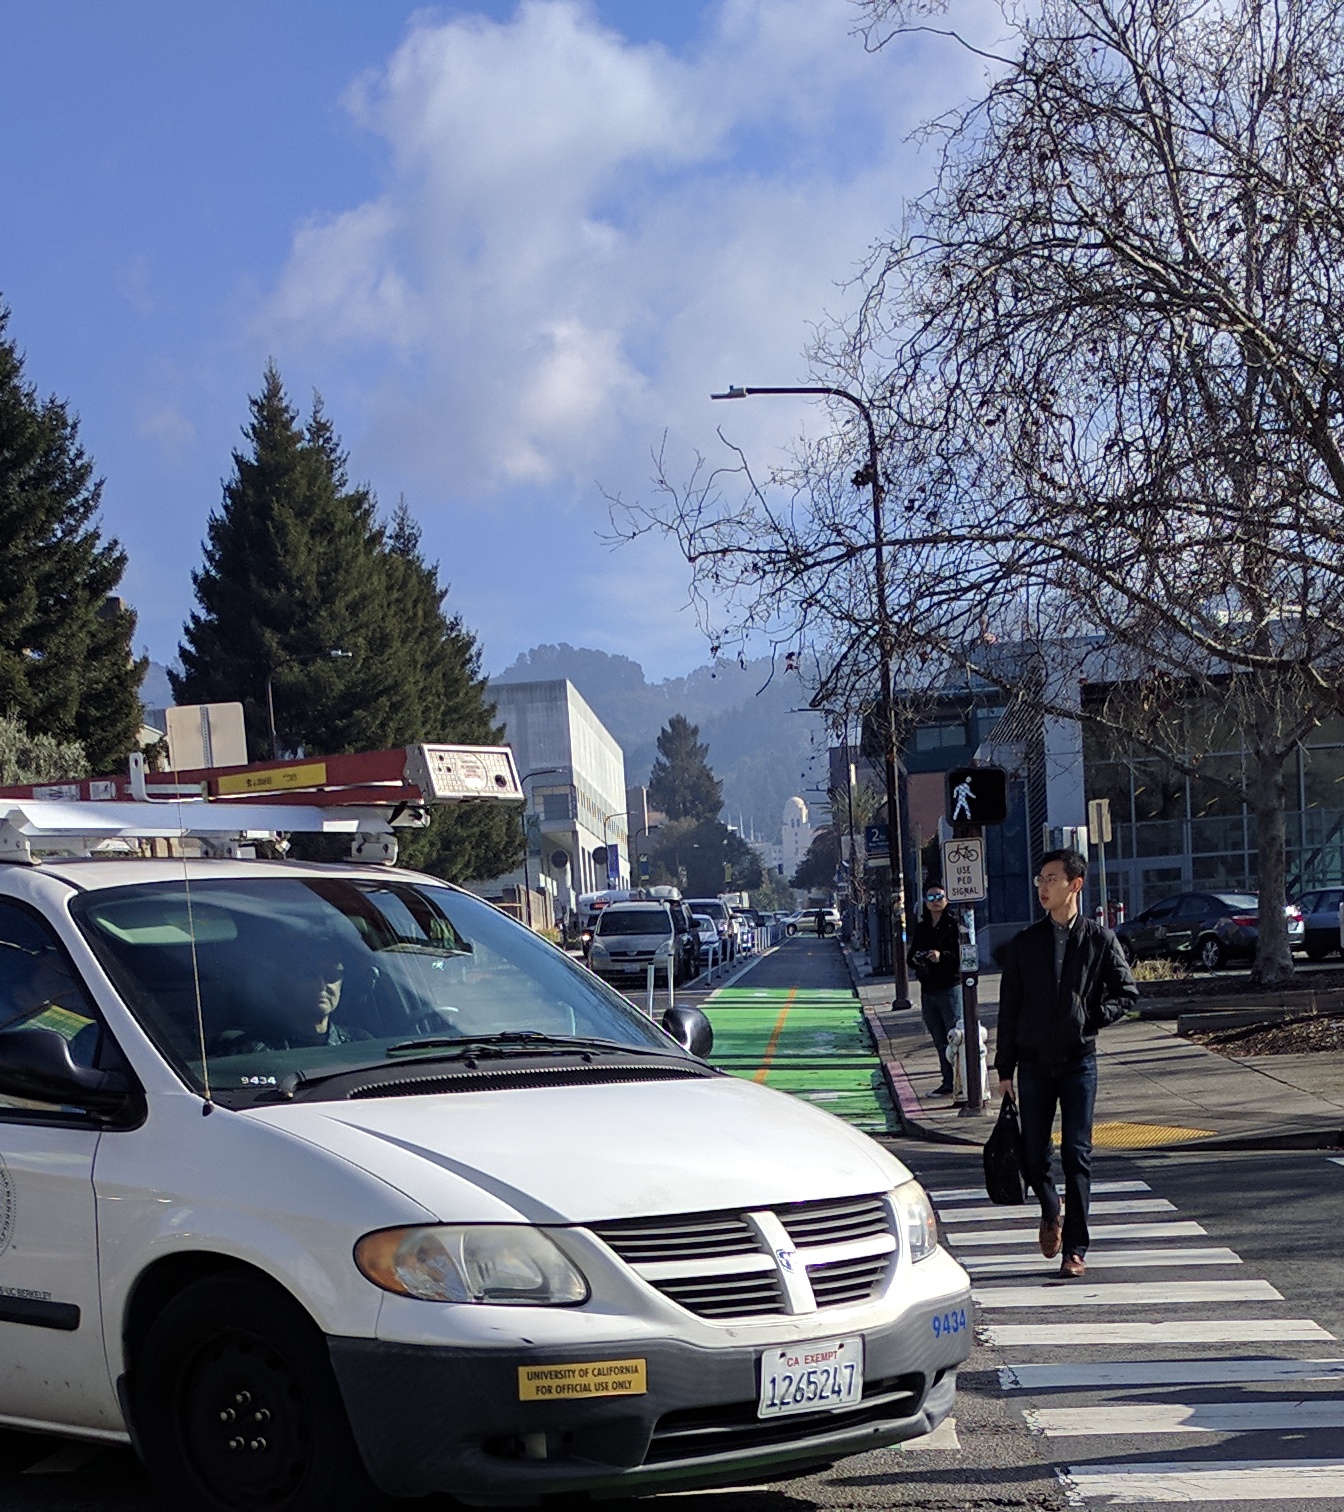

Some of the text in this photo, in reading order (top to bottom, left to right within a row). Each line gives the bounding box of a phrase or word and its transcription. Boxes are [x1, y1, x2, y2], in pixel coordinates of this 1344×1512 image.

[956, 865, 971, 875] USE
[957, 876, 972, 885] PED
[952, 886, 979, 896] SIGNAL
[240, 1075, 277, 1085] 9434
[932, 1308, 966, 1339] 9434
[786, 1350, 838, 1368] CA EXEMPT
[527, 1365, 639, 1381] UNIVERSITY OF CALIFORNIA
[536, 1380, 632, 1395] FOR OFFICIAL USE ONLY
[765, 1363, 855, 1408] 1265247
